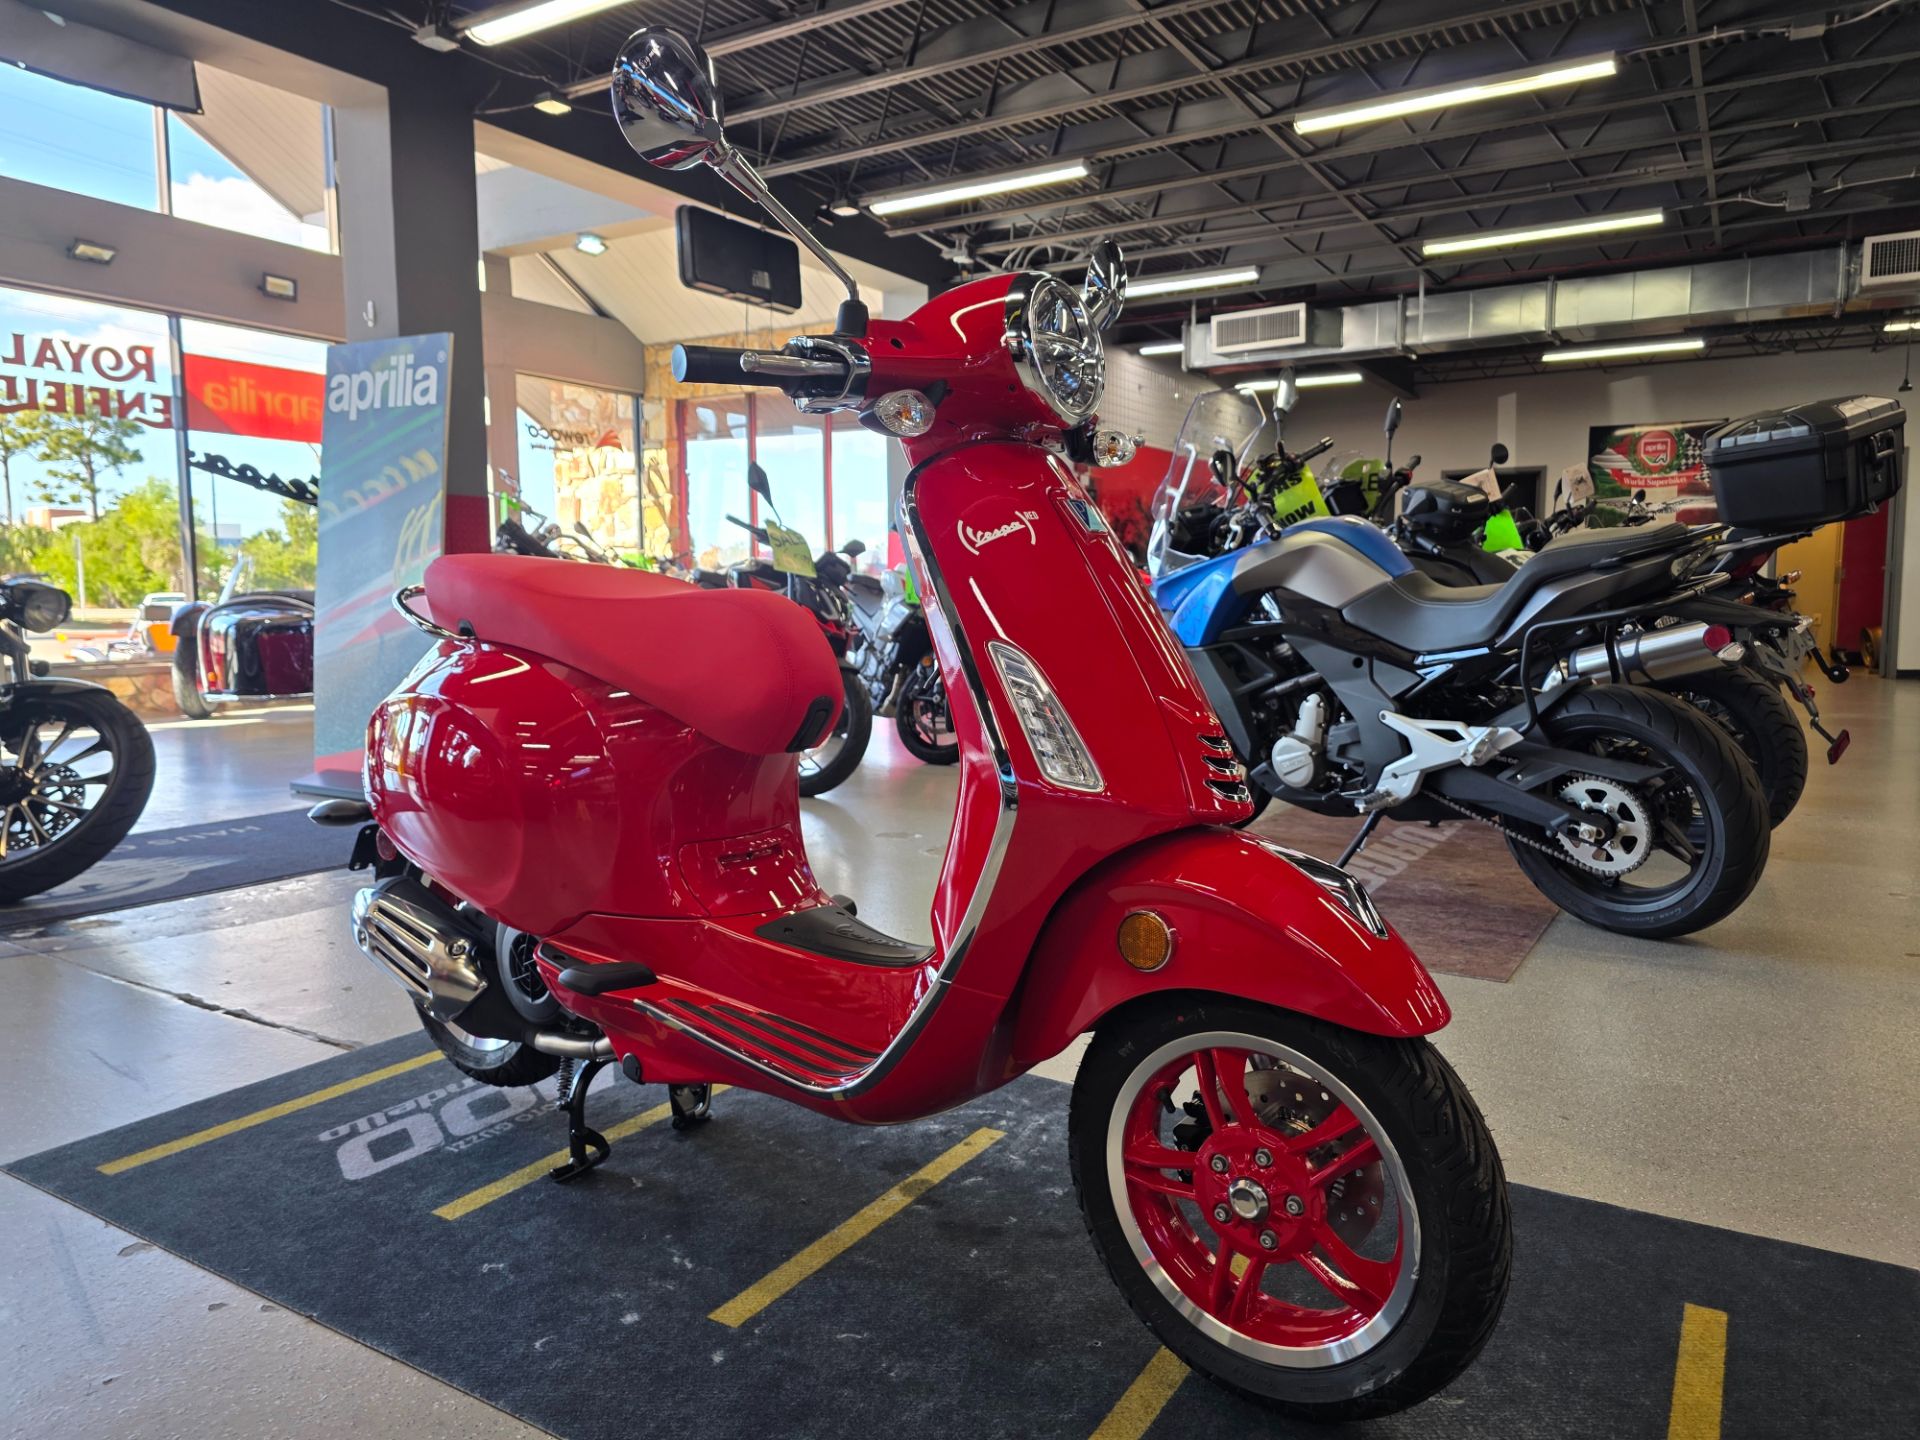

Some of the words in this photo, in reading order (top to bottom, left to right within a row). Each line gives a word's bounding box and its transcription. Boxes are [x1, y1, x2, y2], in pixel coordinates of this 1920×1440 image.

[328, 354, 439, 421] aprilia
[318, 1075, 482, 1142] ndello
[515, 1102, 558, 1124] OTO
